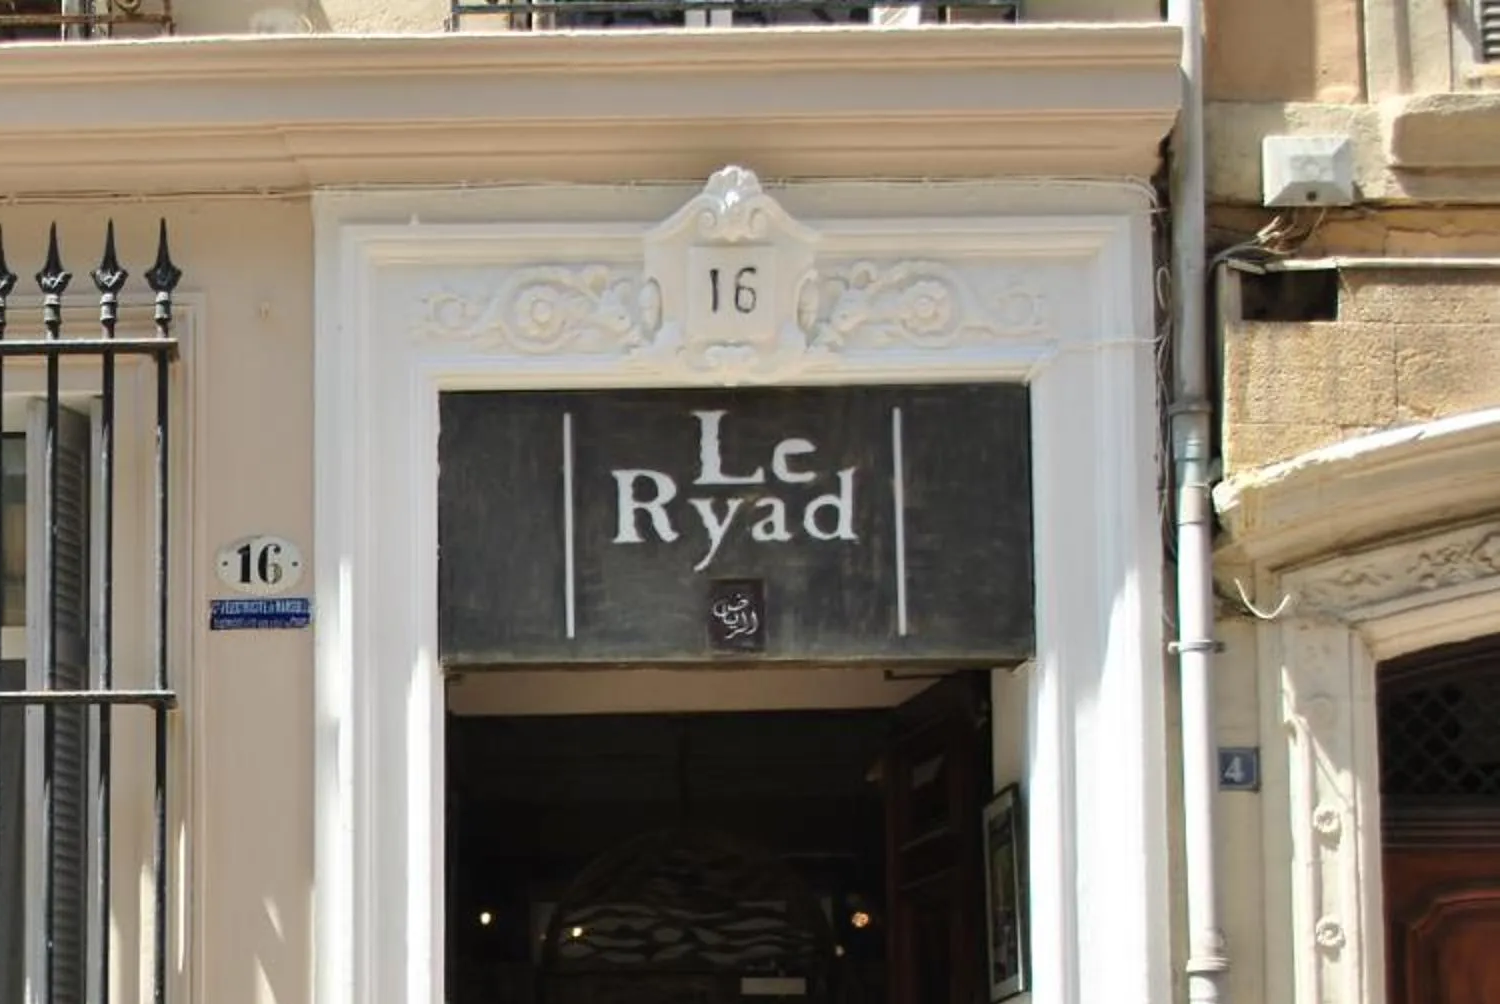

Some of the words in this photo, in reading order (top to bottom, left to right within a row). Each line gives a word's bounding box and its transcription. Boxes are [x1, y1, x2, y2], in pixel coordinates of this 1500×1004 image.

[709, 266, 757, 314] 16
[690, 409, 817, 484] Le
[611, 466, 860, 572] Ryad
[237, 543, 283, 584] 16
[1224, 755, 1245, 783] 4
